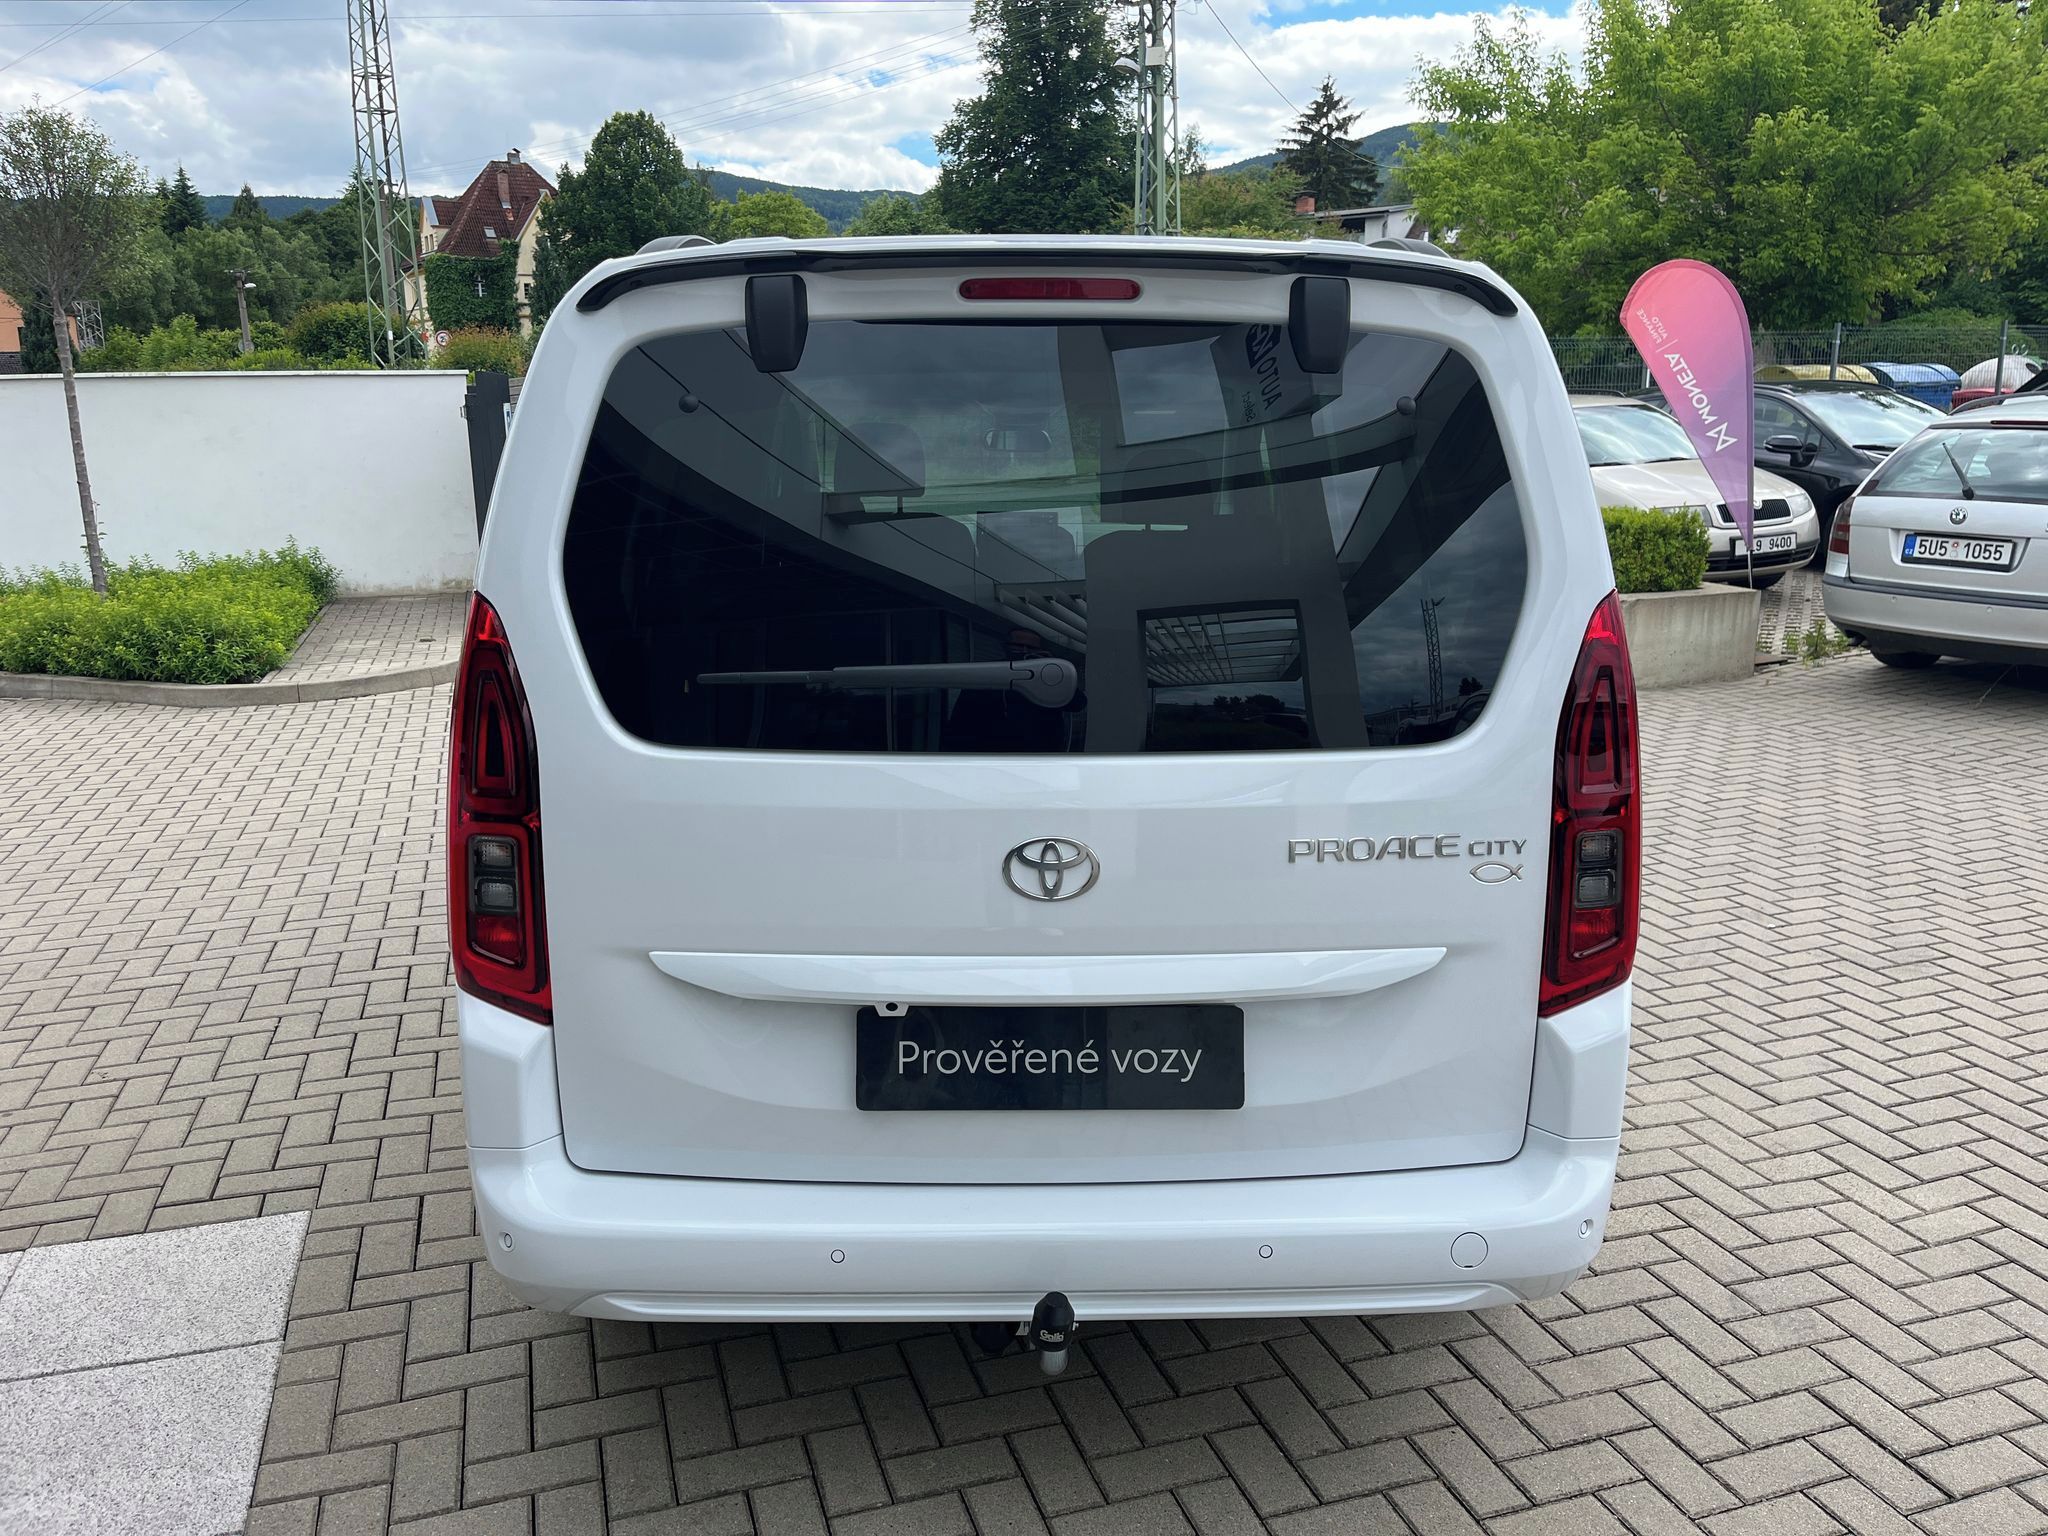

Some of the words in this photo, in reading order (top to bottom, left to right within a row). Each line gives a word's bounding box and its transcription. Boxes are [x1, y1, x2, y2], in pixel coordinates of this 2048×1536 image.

[1768, 536, 1792, 550] 9400
[1918, 539, 1949, 557] 5U5
[1963, 541, 2005, 561] 1055
[1288, 833, 1462, 864] PROACE
[1468, 838, 1528, 857] CITY
[898, 1039, 1100, 1075] Prověřené
[1111, 1047, 1203, 1083] vozy
